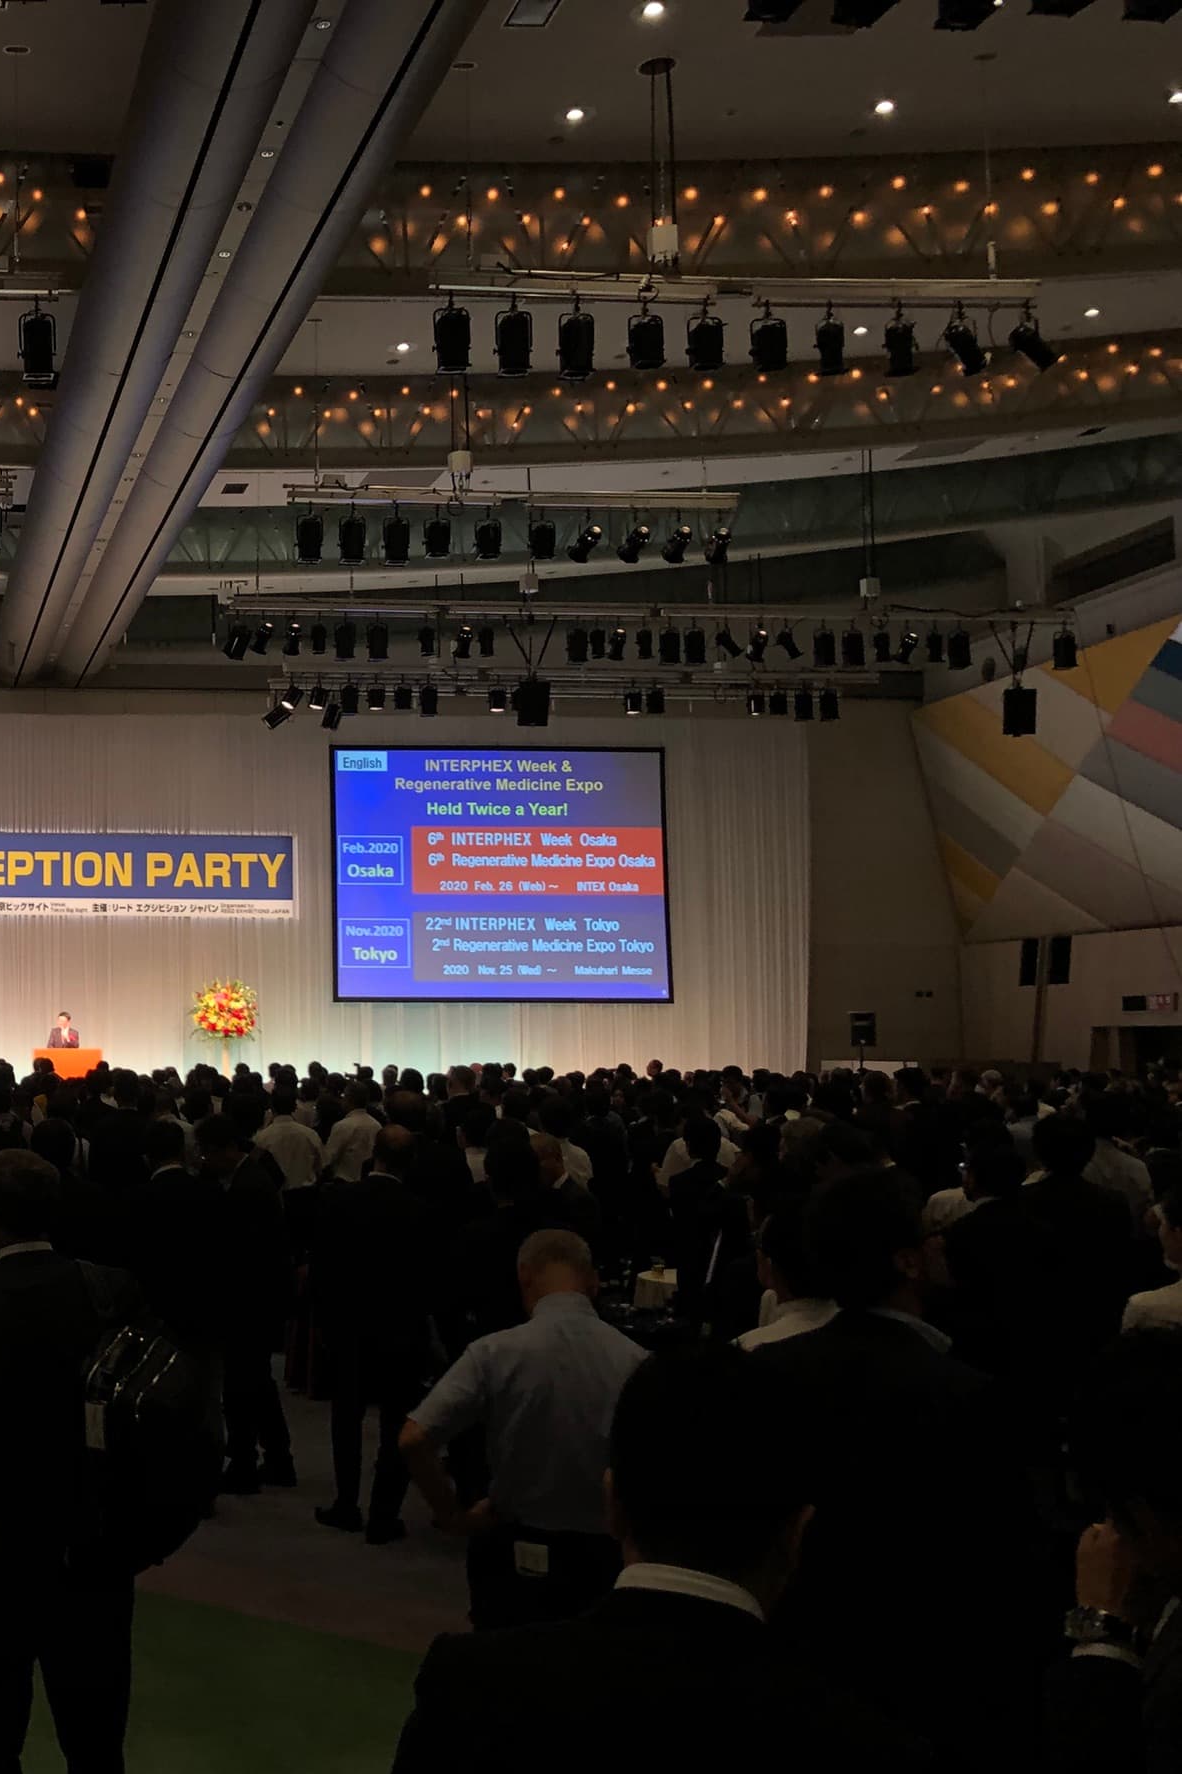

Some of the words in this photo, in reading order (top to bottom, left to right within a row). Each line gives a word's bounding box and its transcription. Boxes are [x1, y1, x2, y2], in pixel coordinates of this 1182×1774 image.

[342, 757, 382, 770] English
[425, 759, 513, 772] INTERPHEX
[517, 760, 558, 773] Week
[561, 760, 572, 773] &
[395, 777, 491, 793] Regenerative
[496, 778, 562, 791] Medicine
[566, 778, 603, 794] Expo
[427, 802, 462, 815] Held
[467, 802, 511, 816] Twice
[515, 805, 525, 816] a
[528, 802, 568, 816] Year!
[452, 832, 532, 846] INTERPHEX
[540, 832, 573, 847] Week
[580, 833, 618, 847] Osaka
[342, 843, 399, 854] Feb.2020
[452, 853, 528, 868] Regenerative
[531, 853, 583, 868] Medicine
[586, 854, 615, 869] Expo
[618, 854, 656, 868] Osaka
[146, 851, 287, 888] PARTY
[347, 863, 394, 878] Osaka
[440, 880, 468, 892] 2020
[474, 880, 495, 892] Feb.
[499, 881, 513, 892] 26
[576, 881, 606, 892] INTEX
[609, 882, 639, 892] Osaka
[345, 925, 404, 937] Nov.2020
[456, 917, 536, 931] INTERPHEX
[544, 917, 577, 932] Week
[583, 917, 620, 932] Tokyo
[453, 938, 529, 953] Regenerative
[532, 938, 583, 953] Medicine
[587, 939, 616, 953] Expo
[619, 939, 655, 954] Tokyo
[352, 947, 398, 964] Tokyo
[443, 964, 469, 976] 2020
[477, 964, 497, 976] Nov.
[499, 964, 513, 976] 25
[622, 965, 653, 976] Messe
